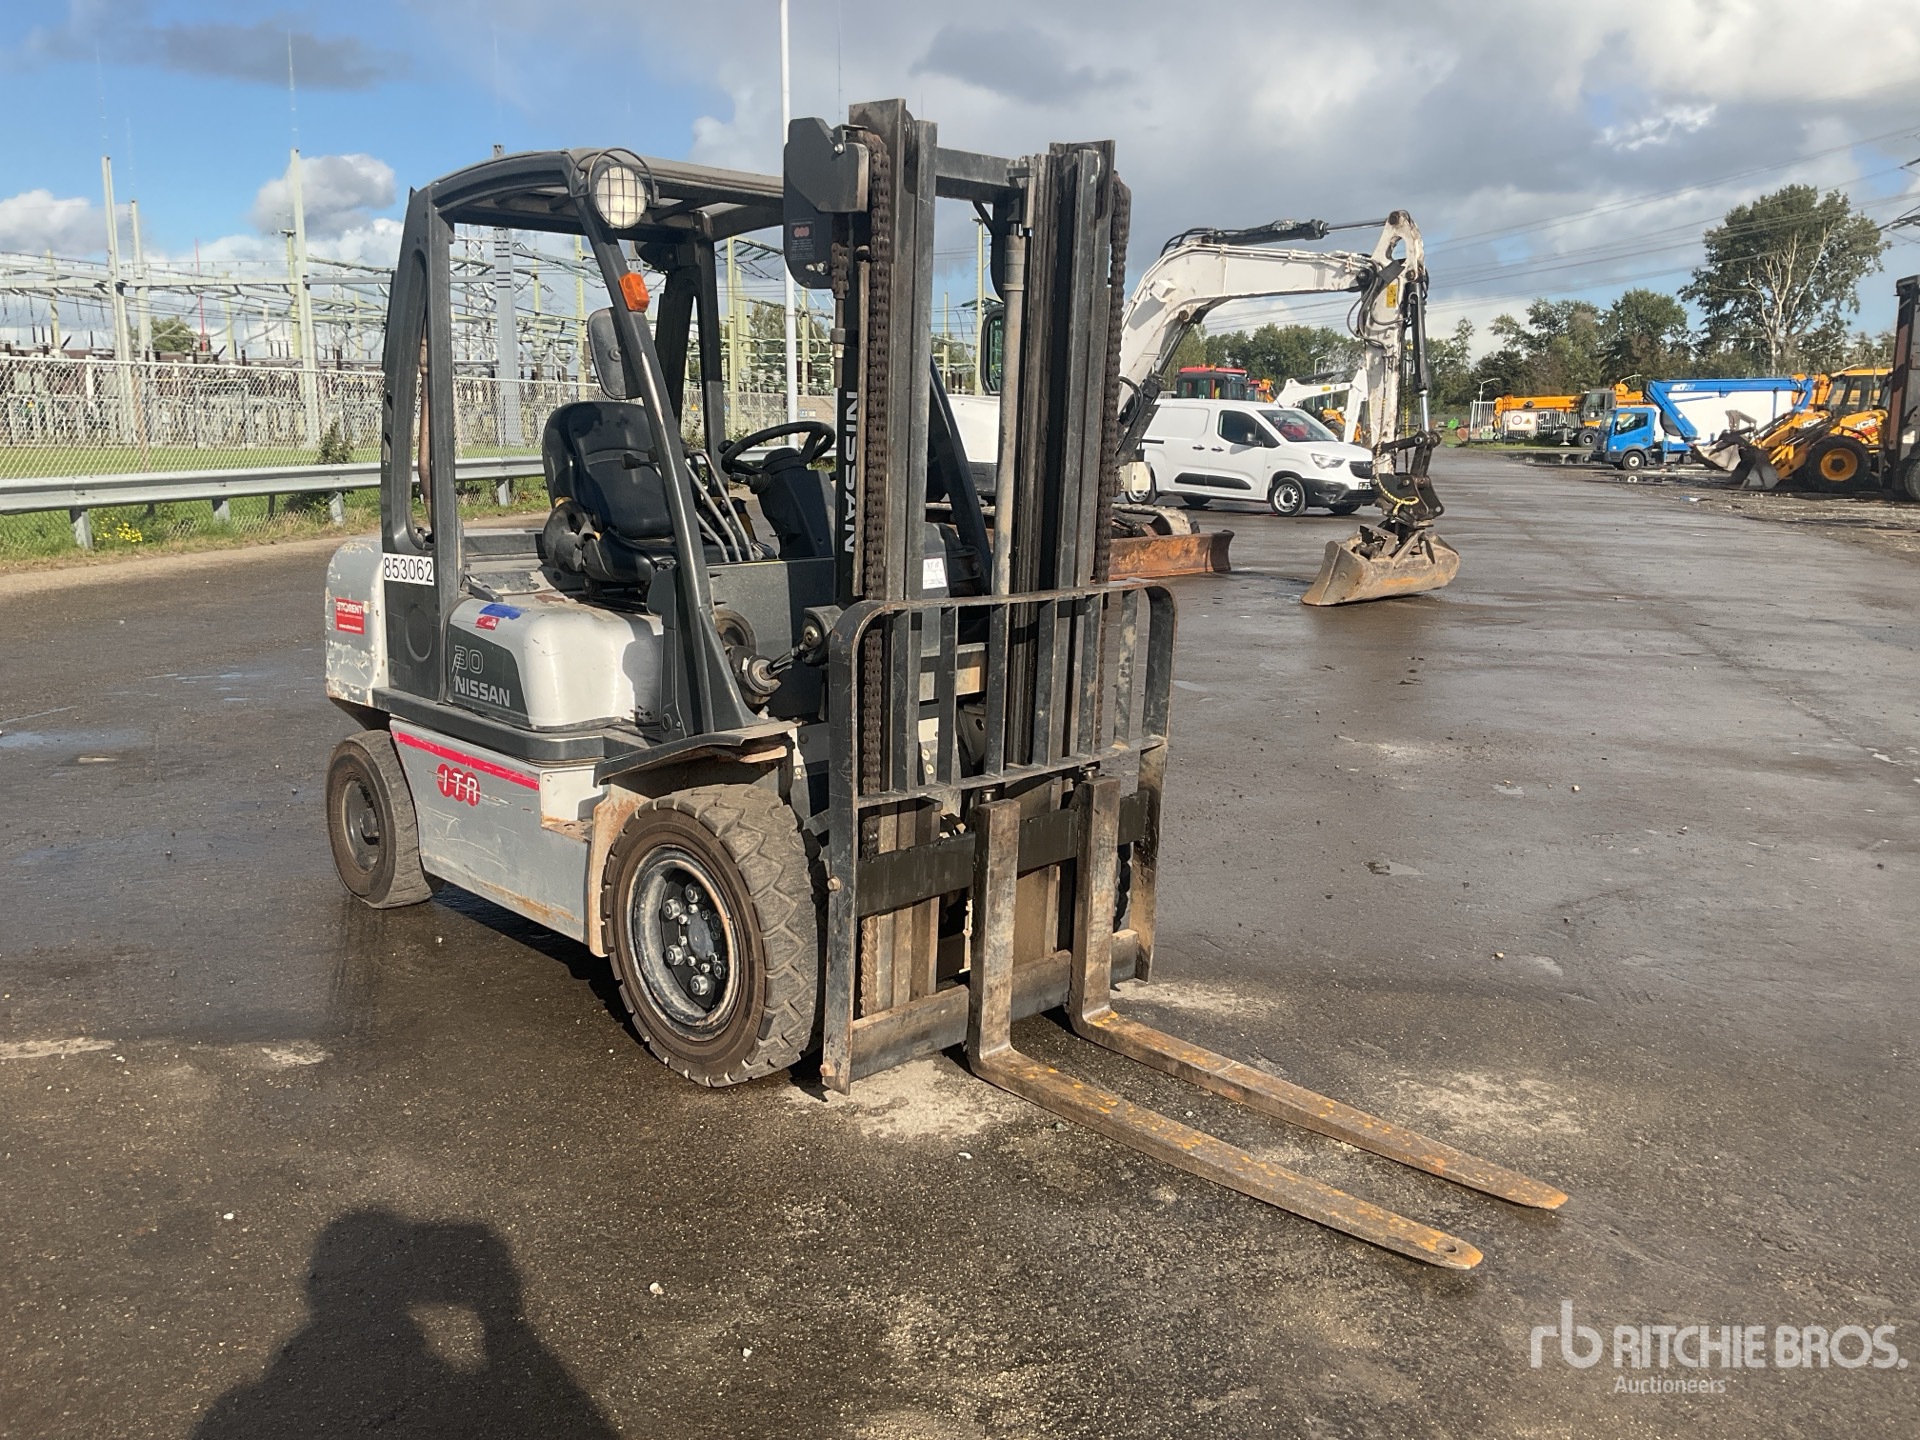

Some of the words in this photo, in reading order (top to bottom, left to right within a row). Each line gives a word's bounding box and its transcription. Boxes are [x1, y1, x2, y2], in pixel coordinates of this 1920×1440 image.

[845, 391, 858, 553] NISSAN
[384, 557, 433, 582] 853062
[454, 645, 484, 674] 30
[454, 675, 510, 707] NISSAN
[443, 769, 478, 802] ITR
